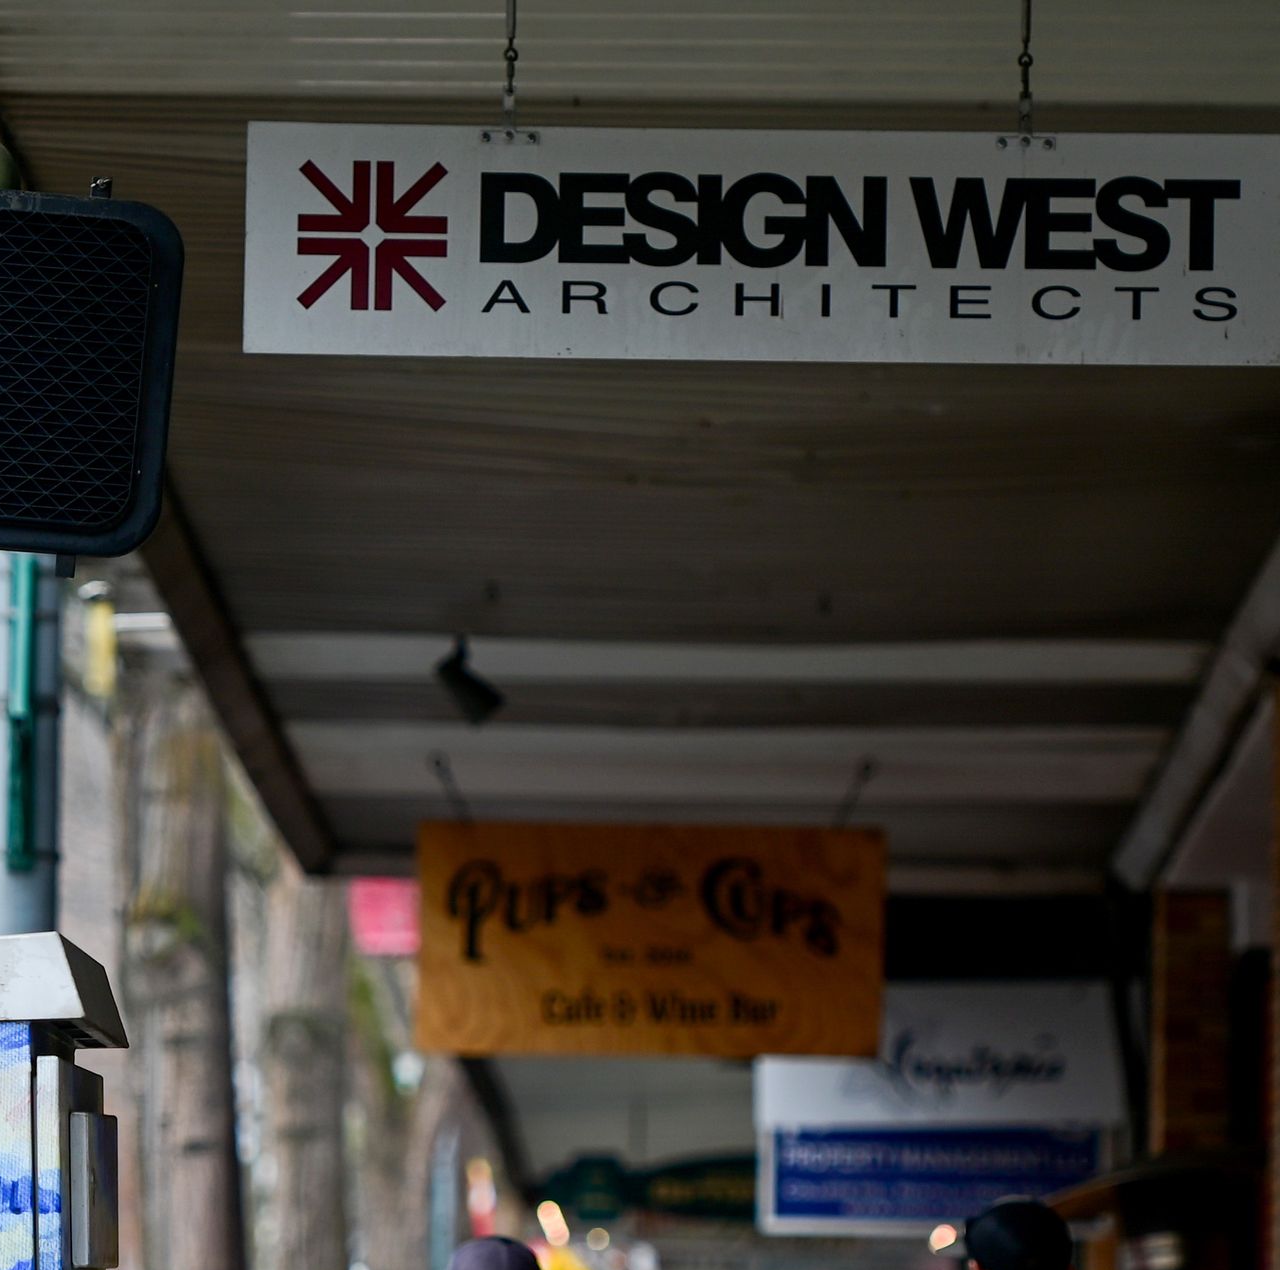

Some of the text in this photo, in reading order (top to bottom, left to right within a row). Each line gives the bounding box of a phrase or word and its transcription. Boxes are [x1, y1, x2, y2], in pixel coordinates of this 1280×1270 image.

[479, 171, 1241, 272] DESIGN WEST
[480, 279, 1240, 322] ARCHITECTS
